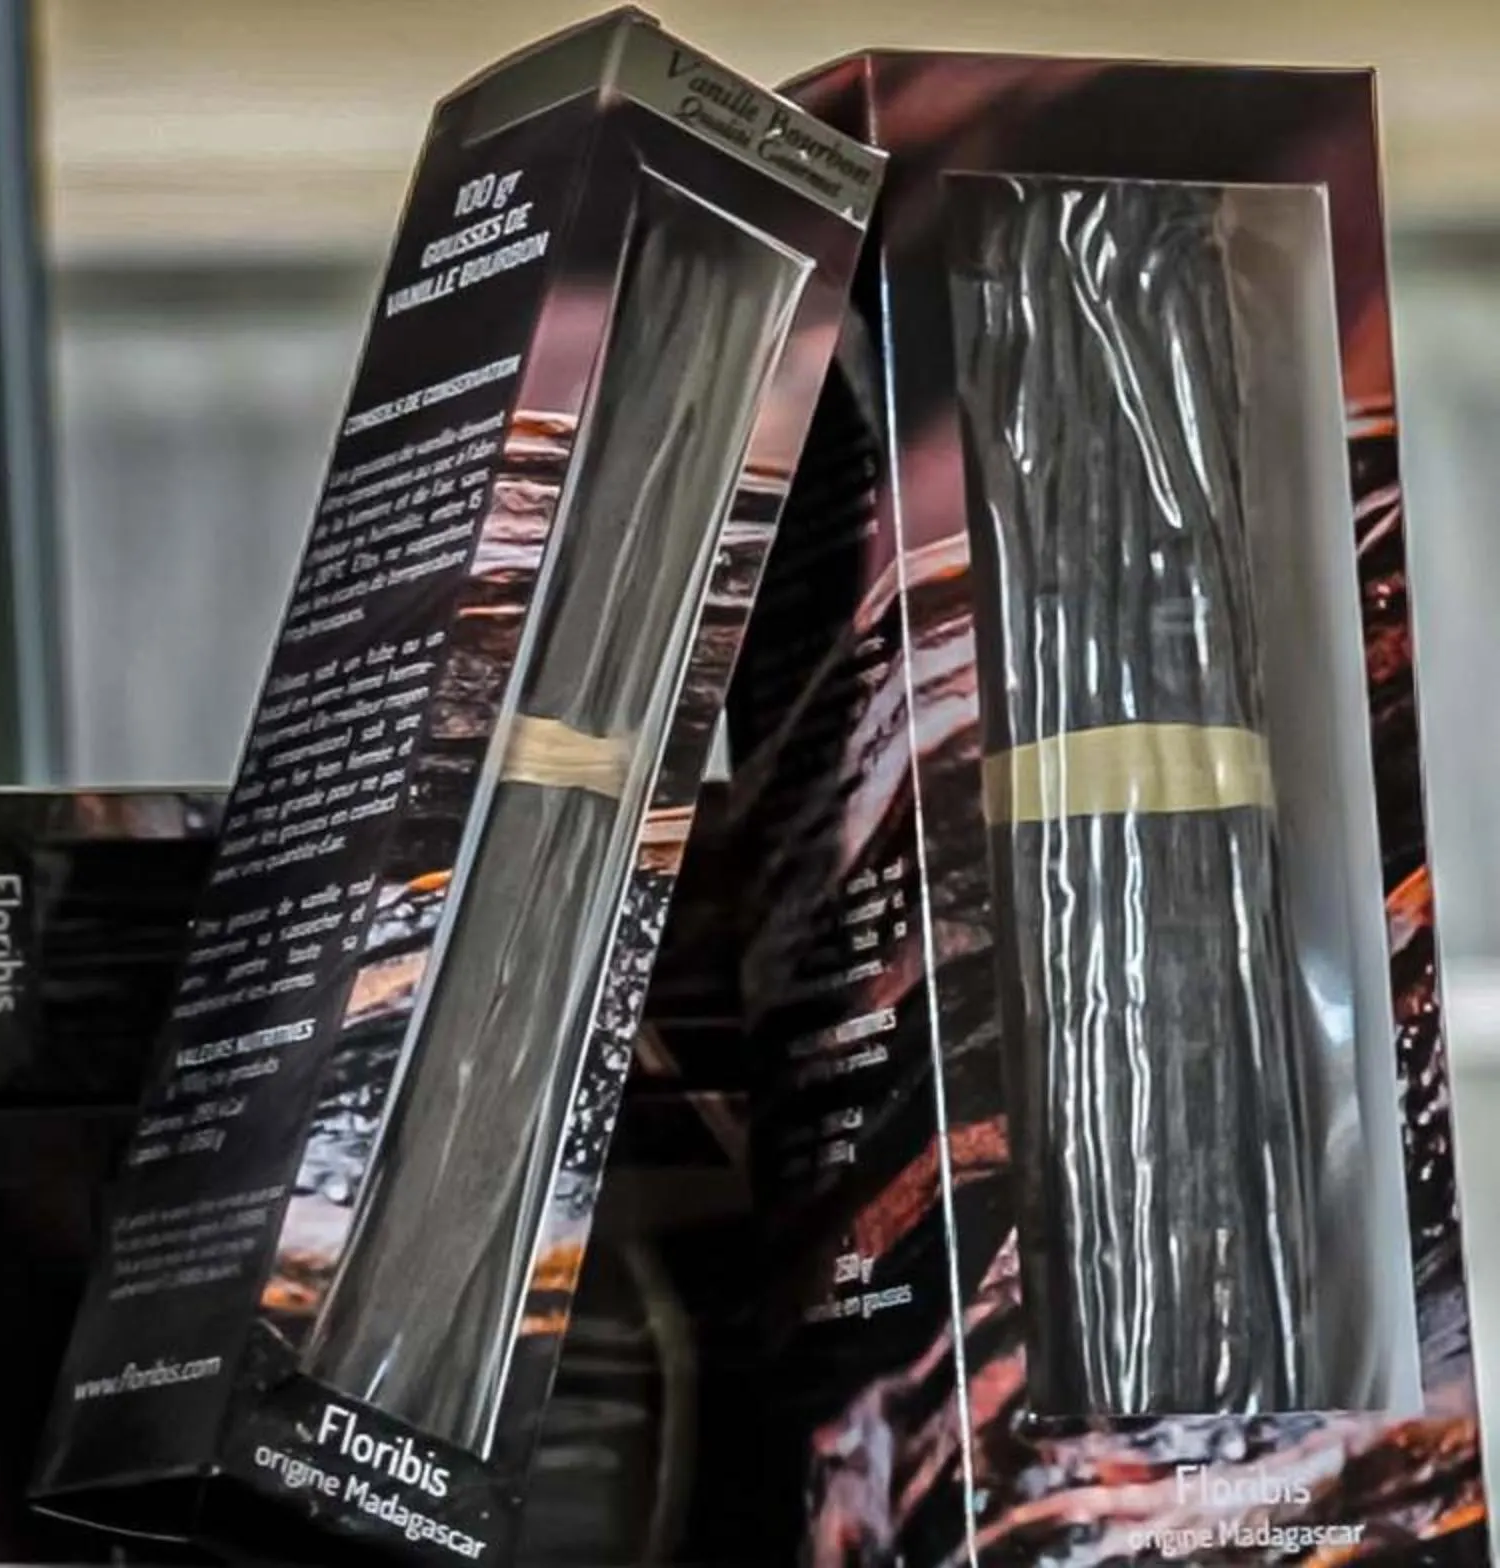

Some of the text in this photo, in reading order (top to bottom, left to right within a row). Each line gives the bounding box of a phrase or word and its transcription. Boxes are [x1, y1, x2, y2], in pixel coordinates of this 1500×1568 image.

[668, 49, 874, 184] Vanille Bourbon
[454, 170, 524, 216] 100 gr
[421, 202, 533, 269] GOUSSES DE
[387, 231, 550, 318] VANILLE BOURBON
[176, 1038, 236, 1068] VALEURS
[74, 1355, 223, 1401] www.floribis.com
[317, 1403, 451, 1497] Floribis
[254, 1445, 487, 1559] origine Madagascar
[1175, 1462, 1311, 1505] Floribis
[1127, 1518, 1366, 1559] origine Madagascar
